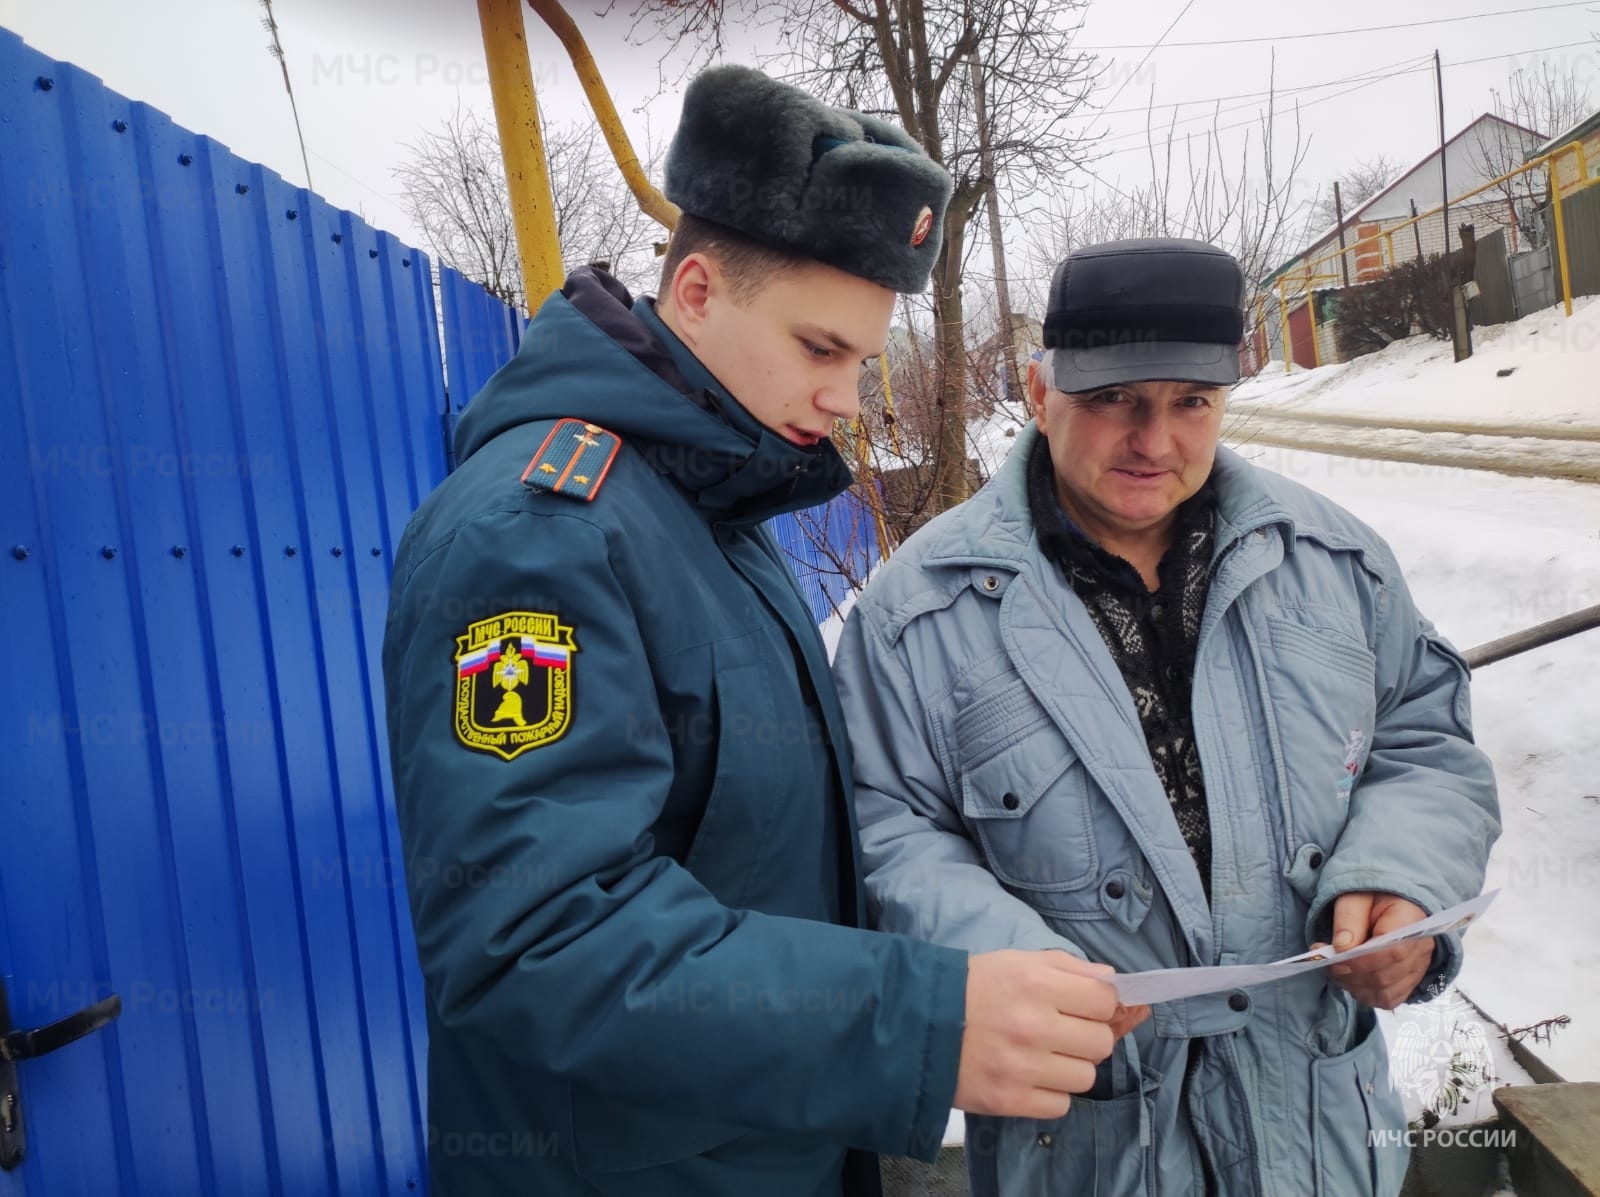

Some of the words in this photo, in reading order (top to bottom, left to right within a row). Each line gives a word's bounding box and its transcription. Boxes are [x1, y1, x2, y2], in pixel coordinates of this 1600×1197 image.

[475, 622, 501, 644] МЧС
[503, 617, 552, 638] РОССИИ
[553, 668, 567, 711] НАДЗОР
